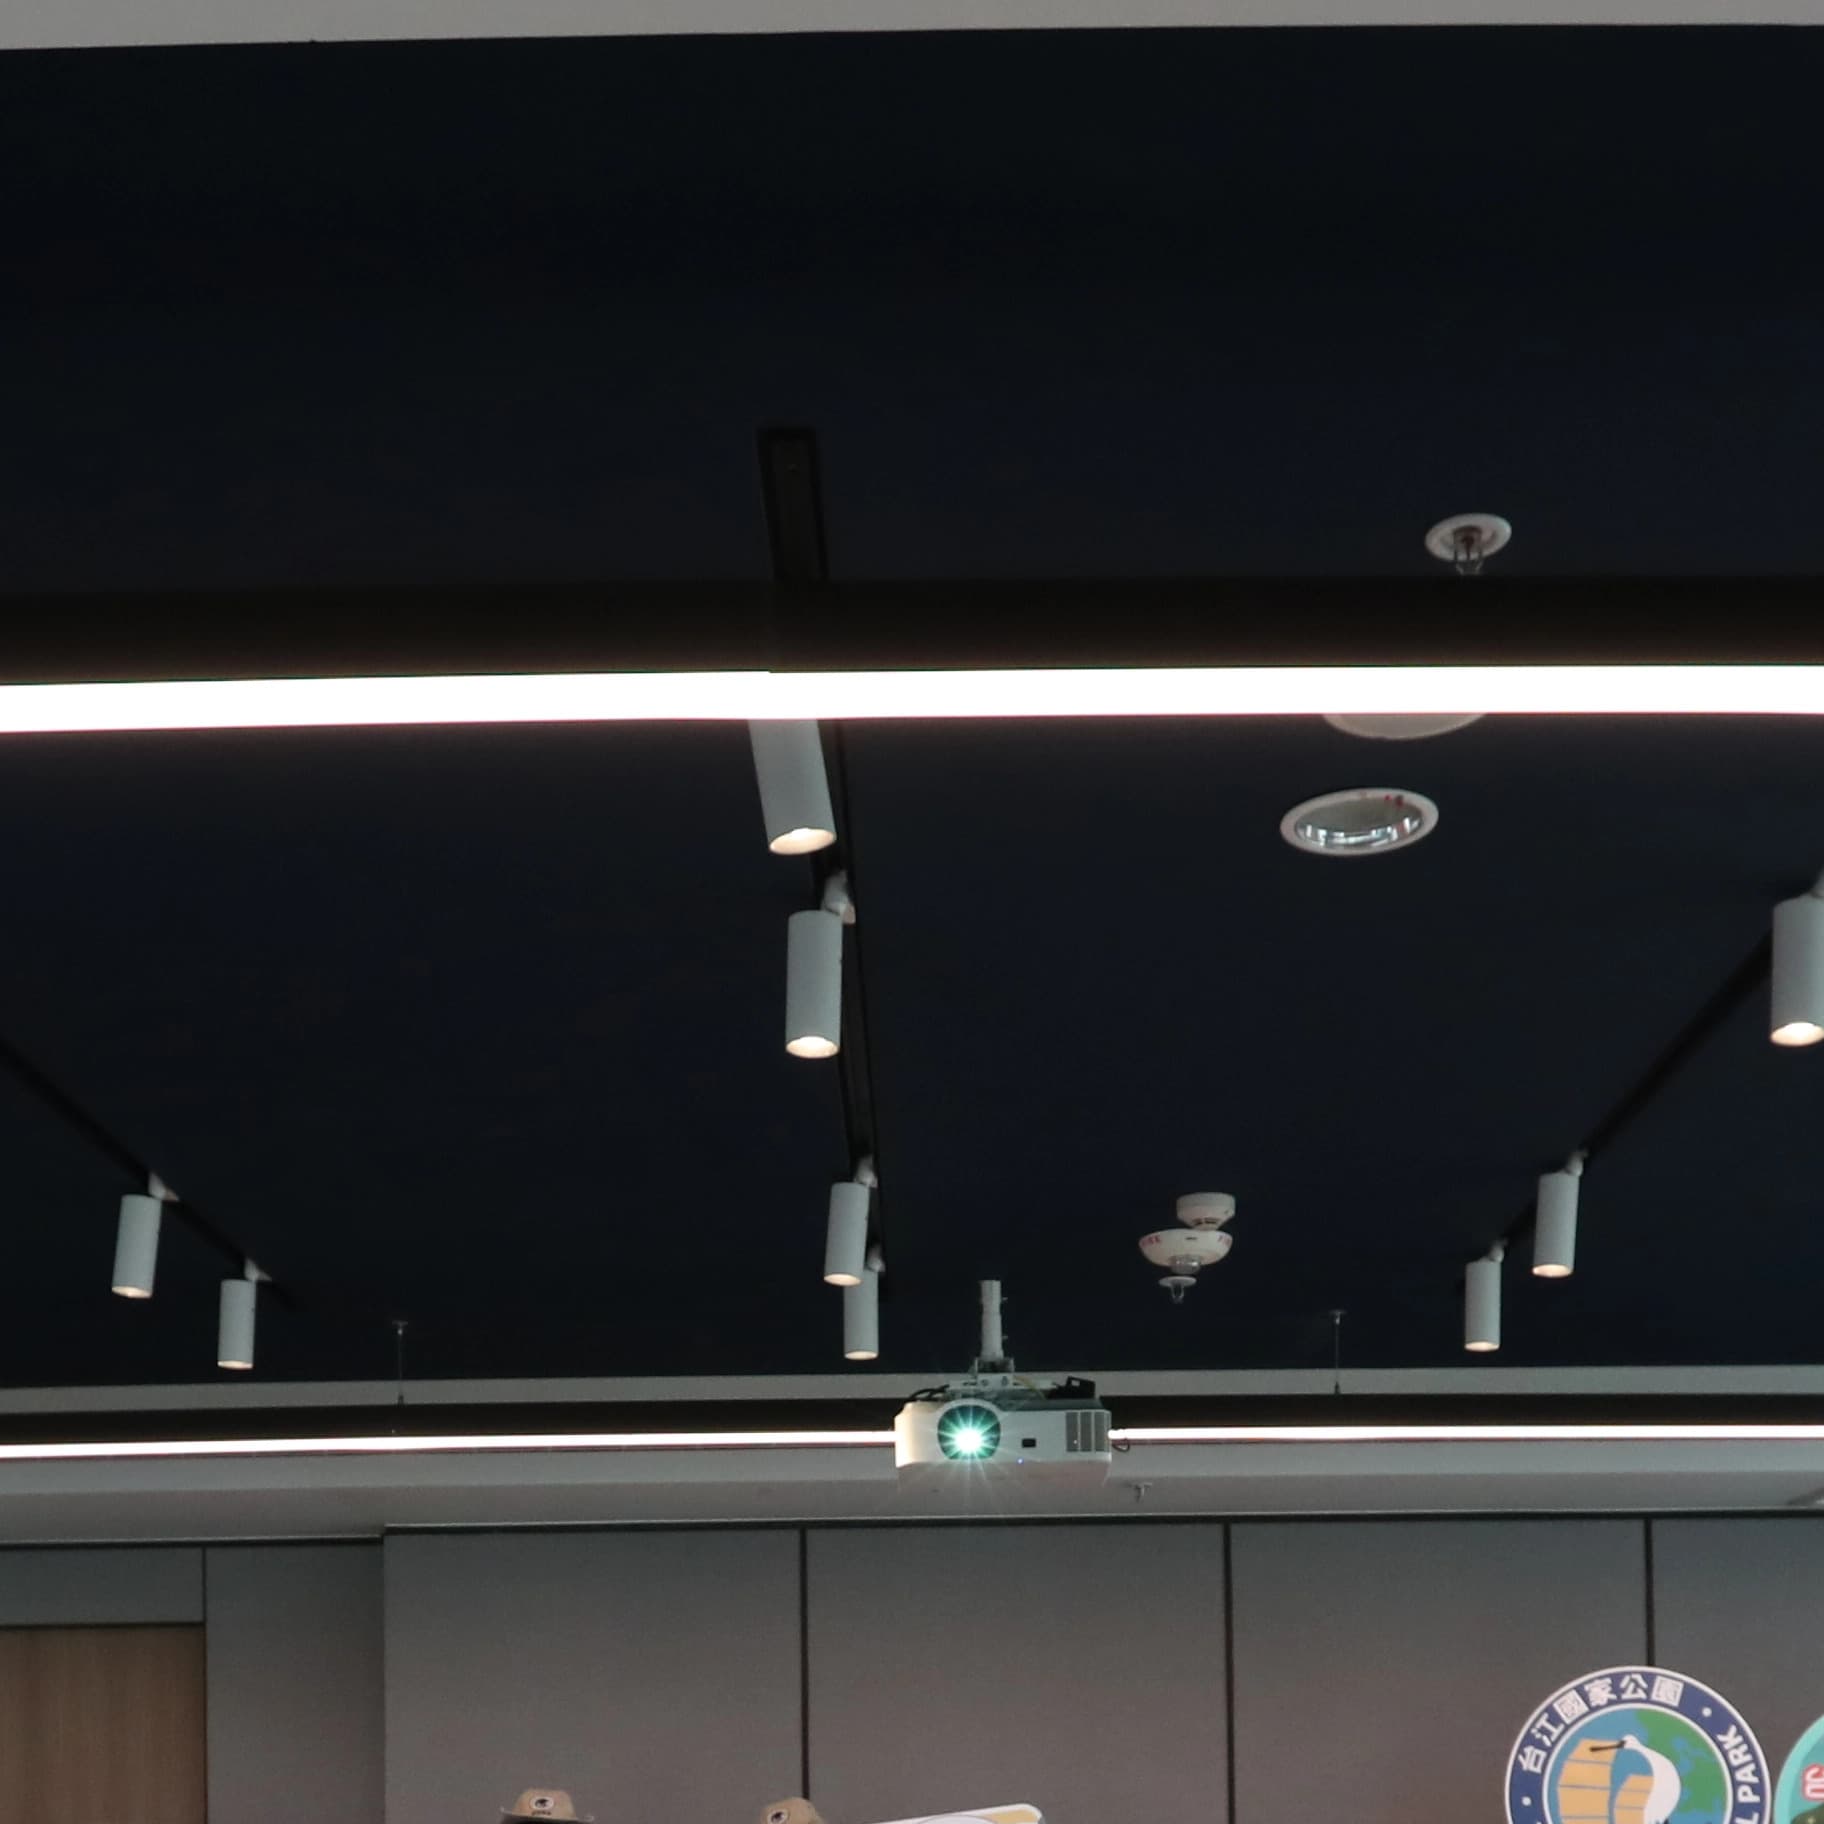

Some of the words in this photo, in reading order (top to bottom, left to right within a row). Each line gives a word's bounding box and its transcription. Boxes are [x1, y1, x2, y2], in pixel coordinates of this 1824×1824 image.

[1518, 1674, 1684, 1773] 台江國家公園
[1717, 1724, 1761, 1803] PARK
